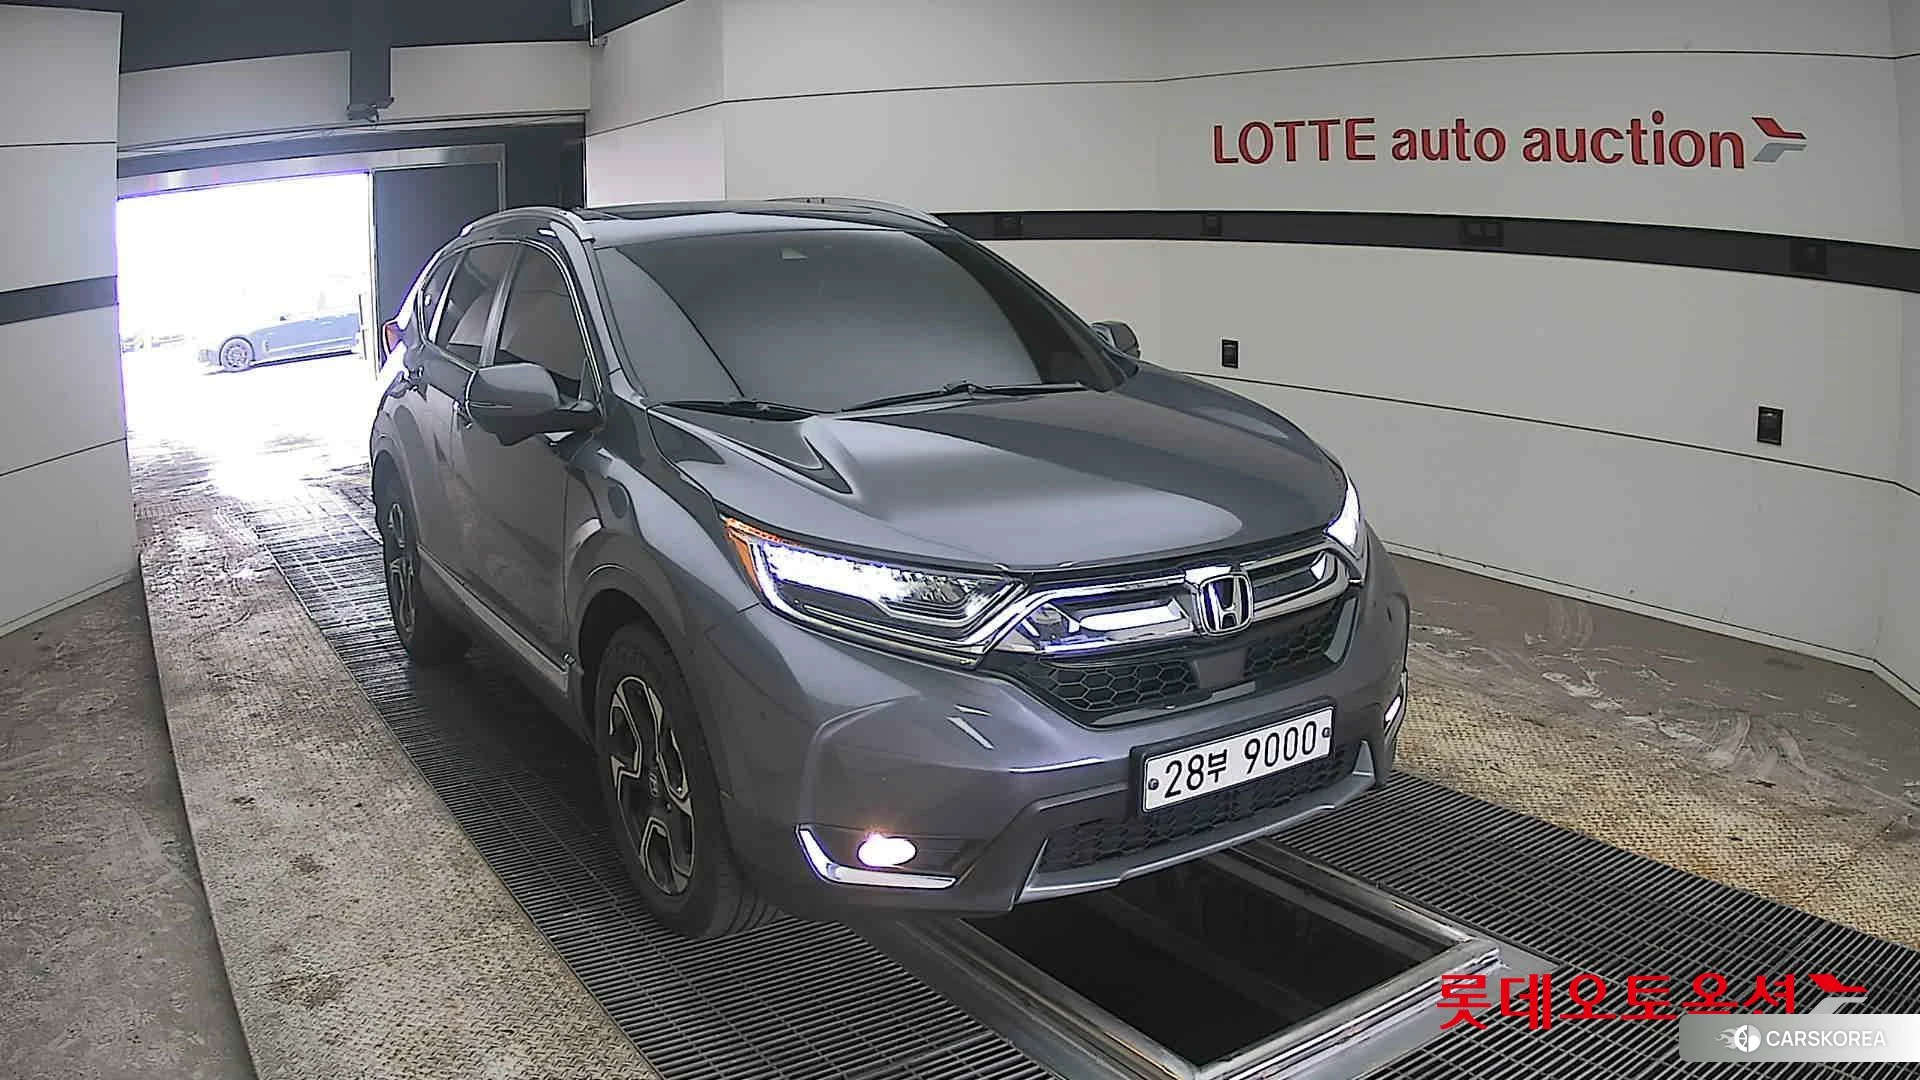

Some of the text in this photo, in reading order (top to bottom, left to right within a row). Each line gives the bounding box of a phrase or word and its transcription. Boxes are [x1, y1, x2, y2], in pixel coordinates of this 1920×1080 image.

[1213, 110, 1745, 170] LOTTE auto auction
[1164, 720, 1317, 798] 28부 9000
